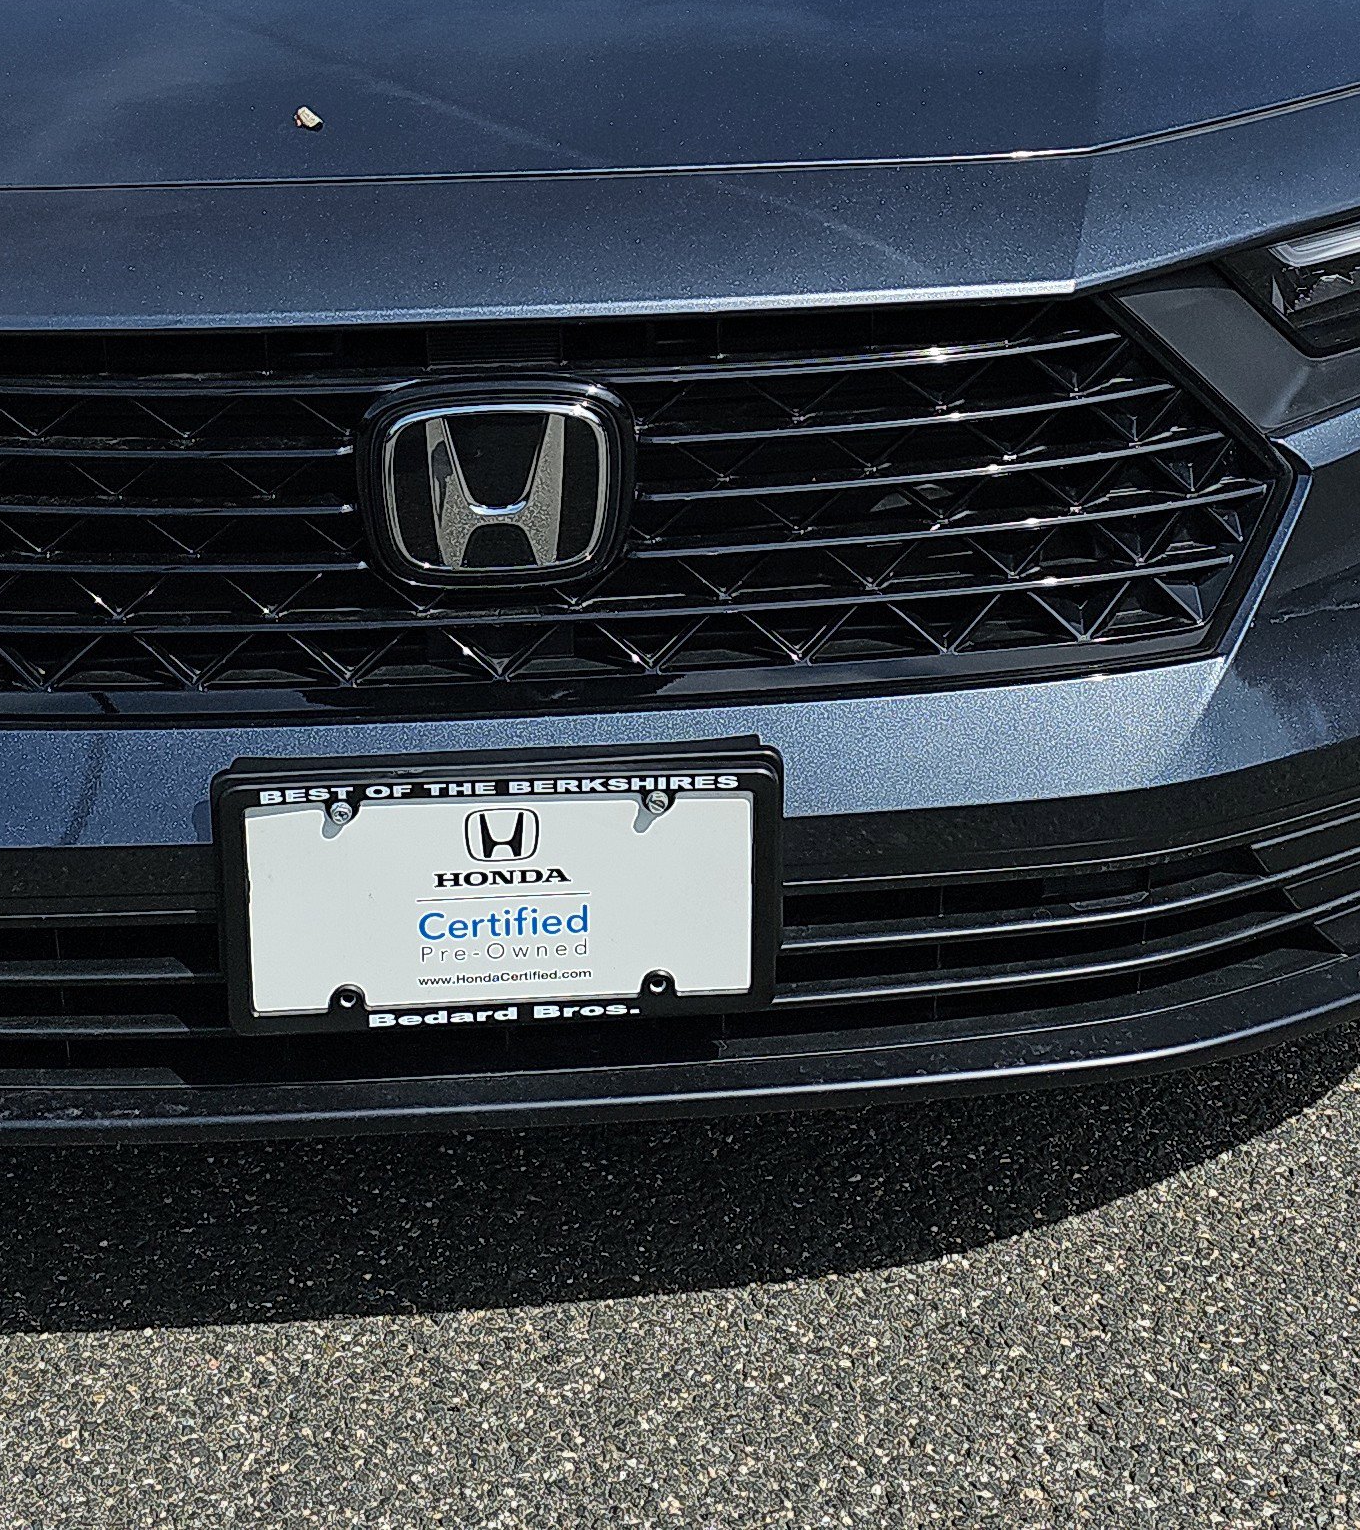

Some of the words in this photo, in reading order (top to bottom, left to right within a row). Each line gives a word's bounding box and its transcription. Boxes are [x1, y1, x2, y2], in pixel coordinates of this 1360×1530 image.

[259, 786, 354, 805] BEST
[365, 784, 413, 798] OF
[424, 781, 497, 796] THE
[508, 775, 739, 794] BERKSHIRES
[433, 868, 572, 889] HONDA
[418, 904, 589, 941] Certified
[420, 938, 588, 964] Pre-Owned
[417, 969, 593, 987] www.HondaCertified.com
[368, 1006, 519, 1028] Bedard
[533, 1003, 641, 1020] Bros.
